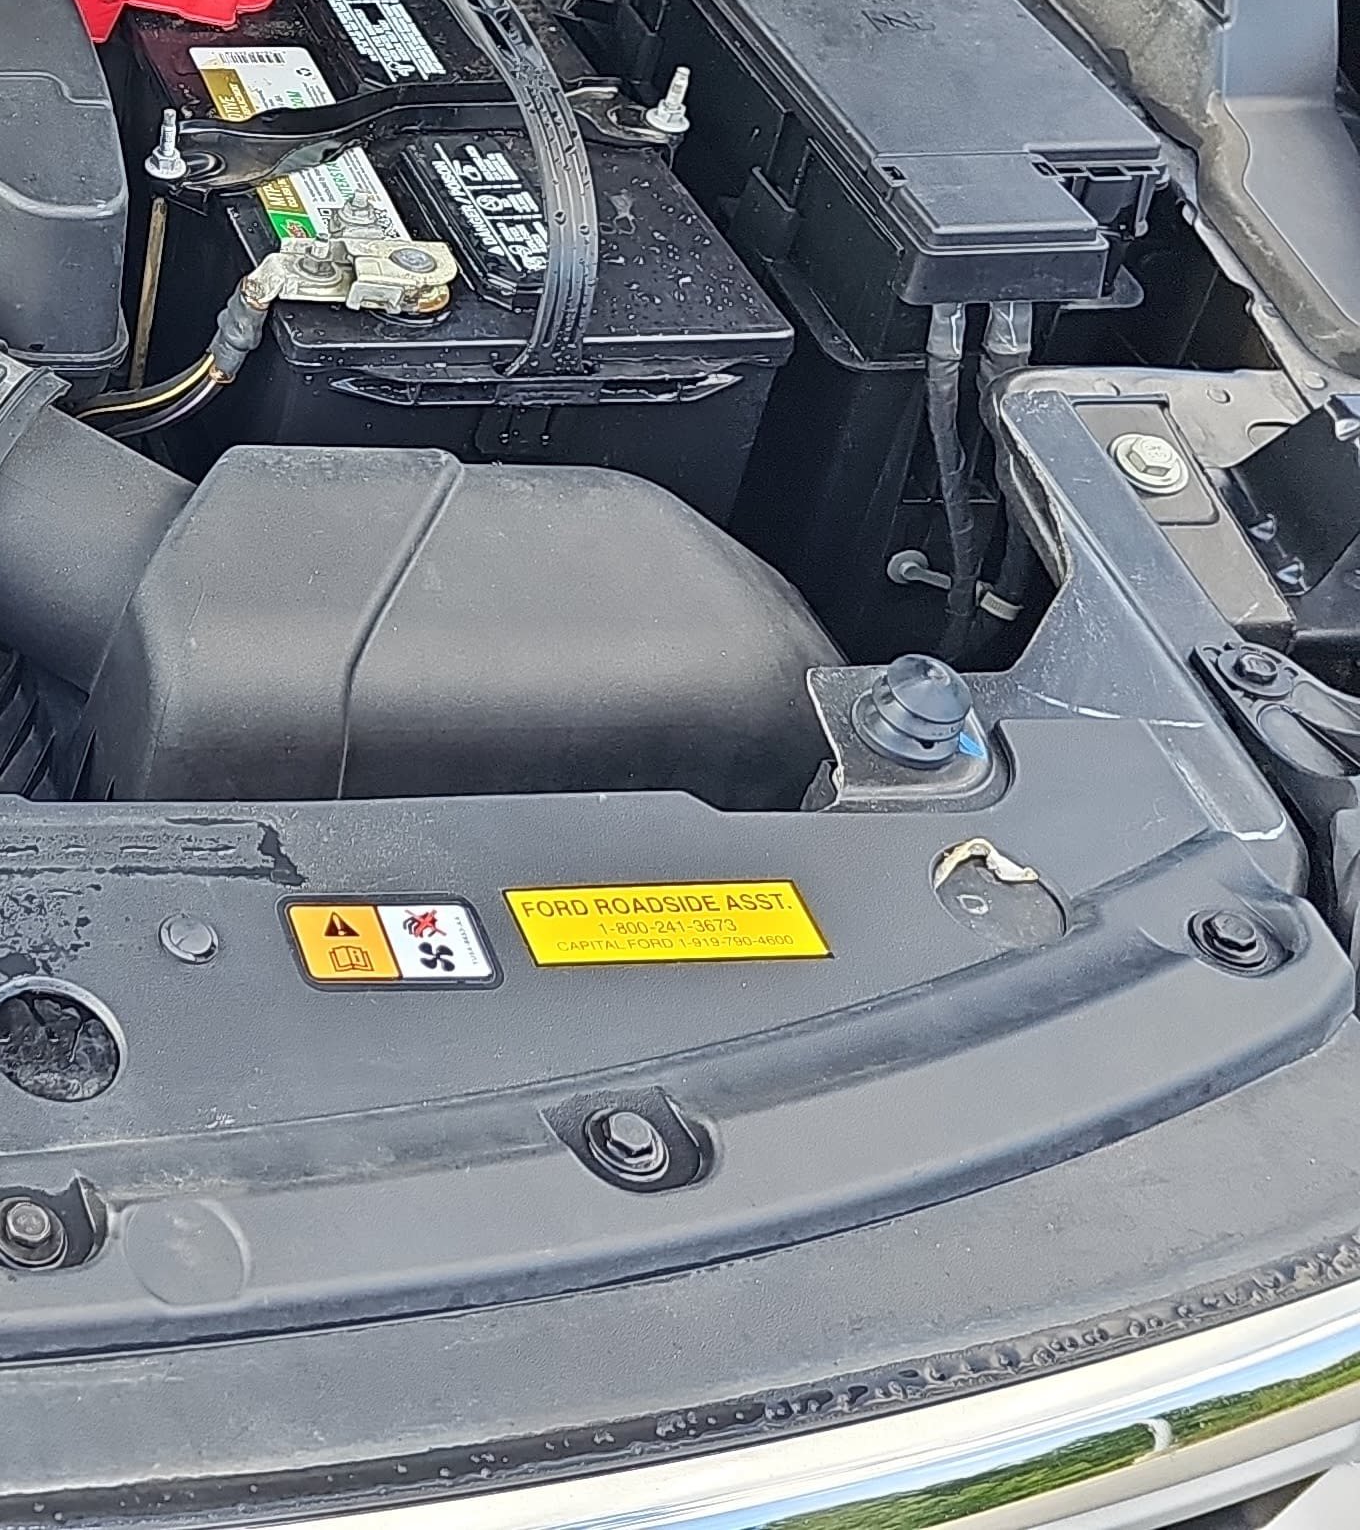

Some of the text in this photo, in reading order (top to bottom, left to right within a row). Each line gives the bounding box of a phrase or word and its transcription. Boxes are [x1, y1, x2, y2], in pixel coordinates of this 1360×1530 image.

[432, 161, 467, 197] POISON
[461, 205, 498, 245] DANGER
[521, 893, 793, 918] FORD ROADSIDE ASST.
[598, 918, 737, 935] 1-800-241-3673
[557, 935, 794, 952] CAPITAL FORD 1-919-790-4600
